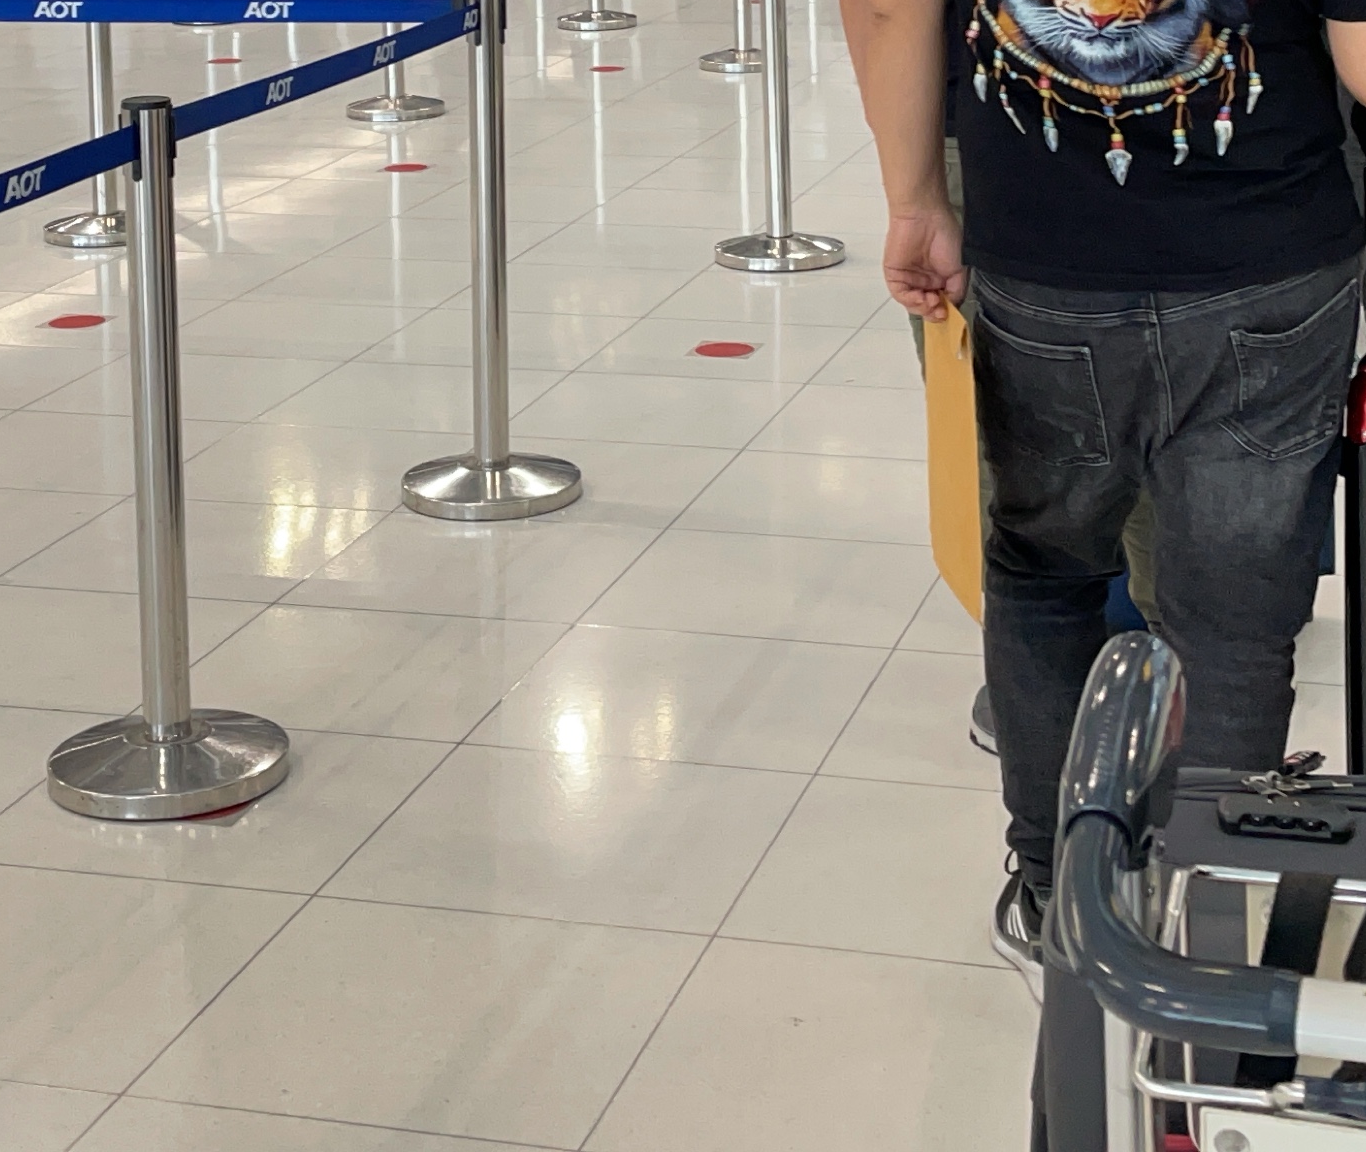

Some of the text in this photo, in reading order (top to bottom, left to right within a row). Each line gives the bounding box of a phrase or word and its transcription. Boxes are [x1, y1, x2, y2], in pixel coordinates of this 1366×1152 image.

[34, 0, 84, 18] AOT
[243, 1, 295, 19] AOT
[463, 8, 479, 32] AO
[373, 40, 396, 66] AOT
[266, 76, 294, 106] AOT
[4, 165, 47, 204] AOT
